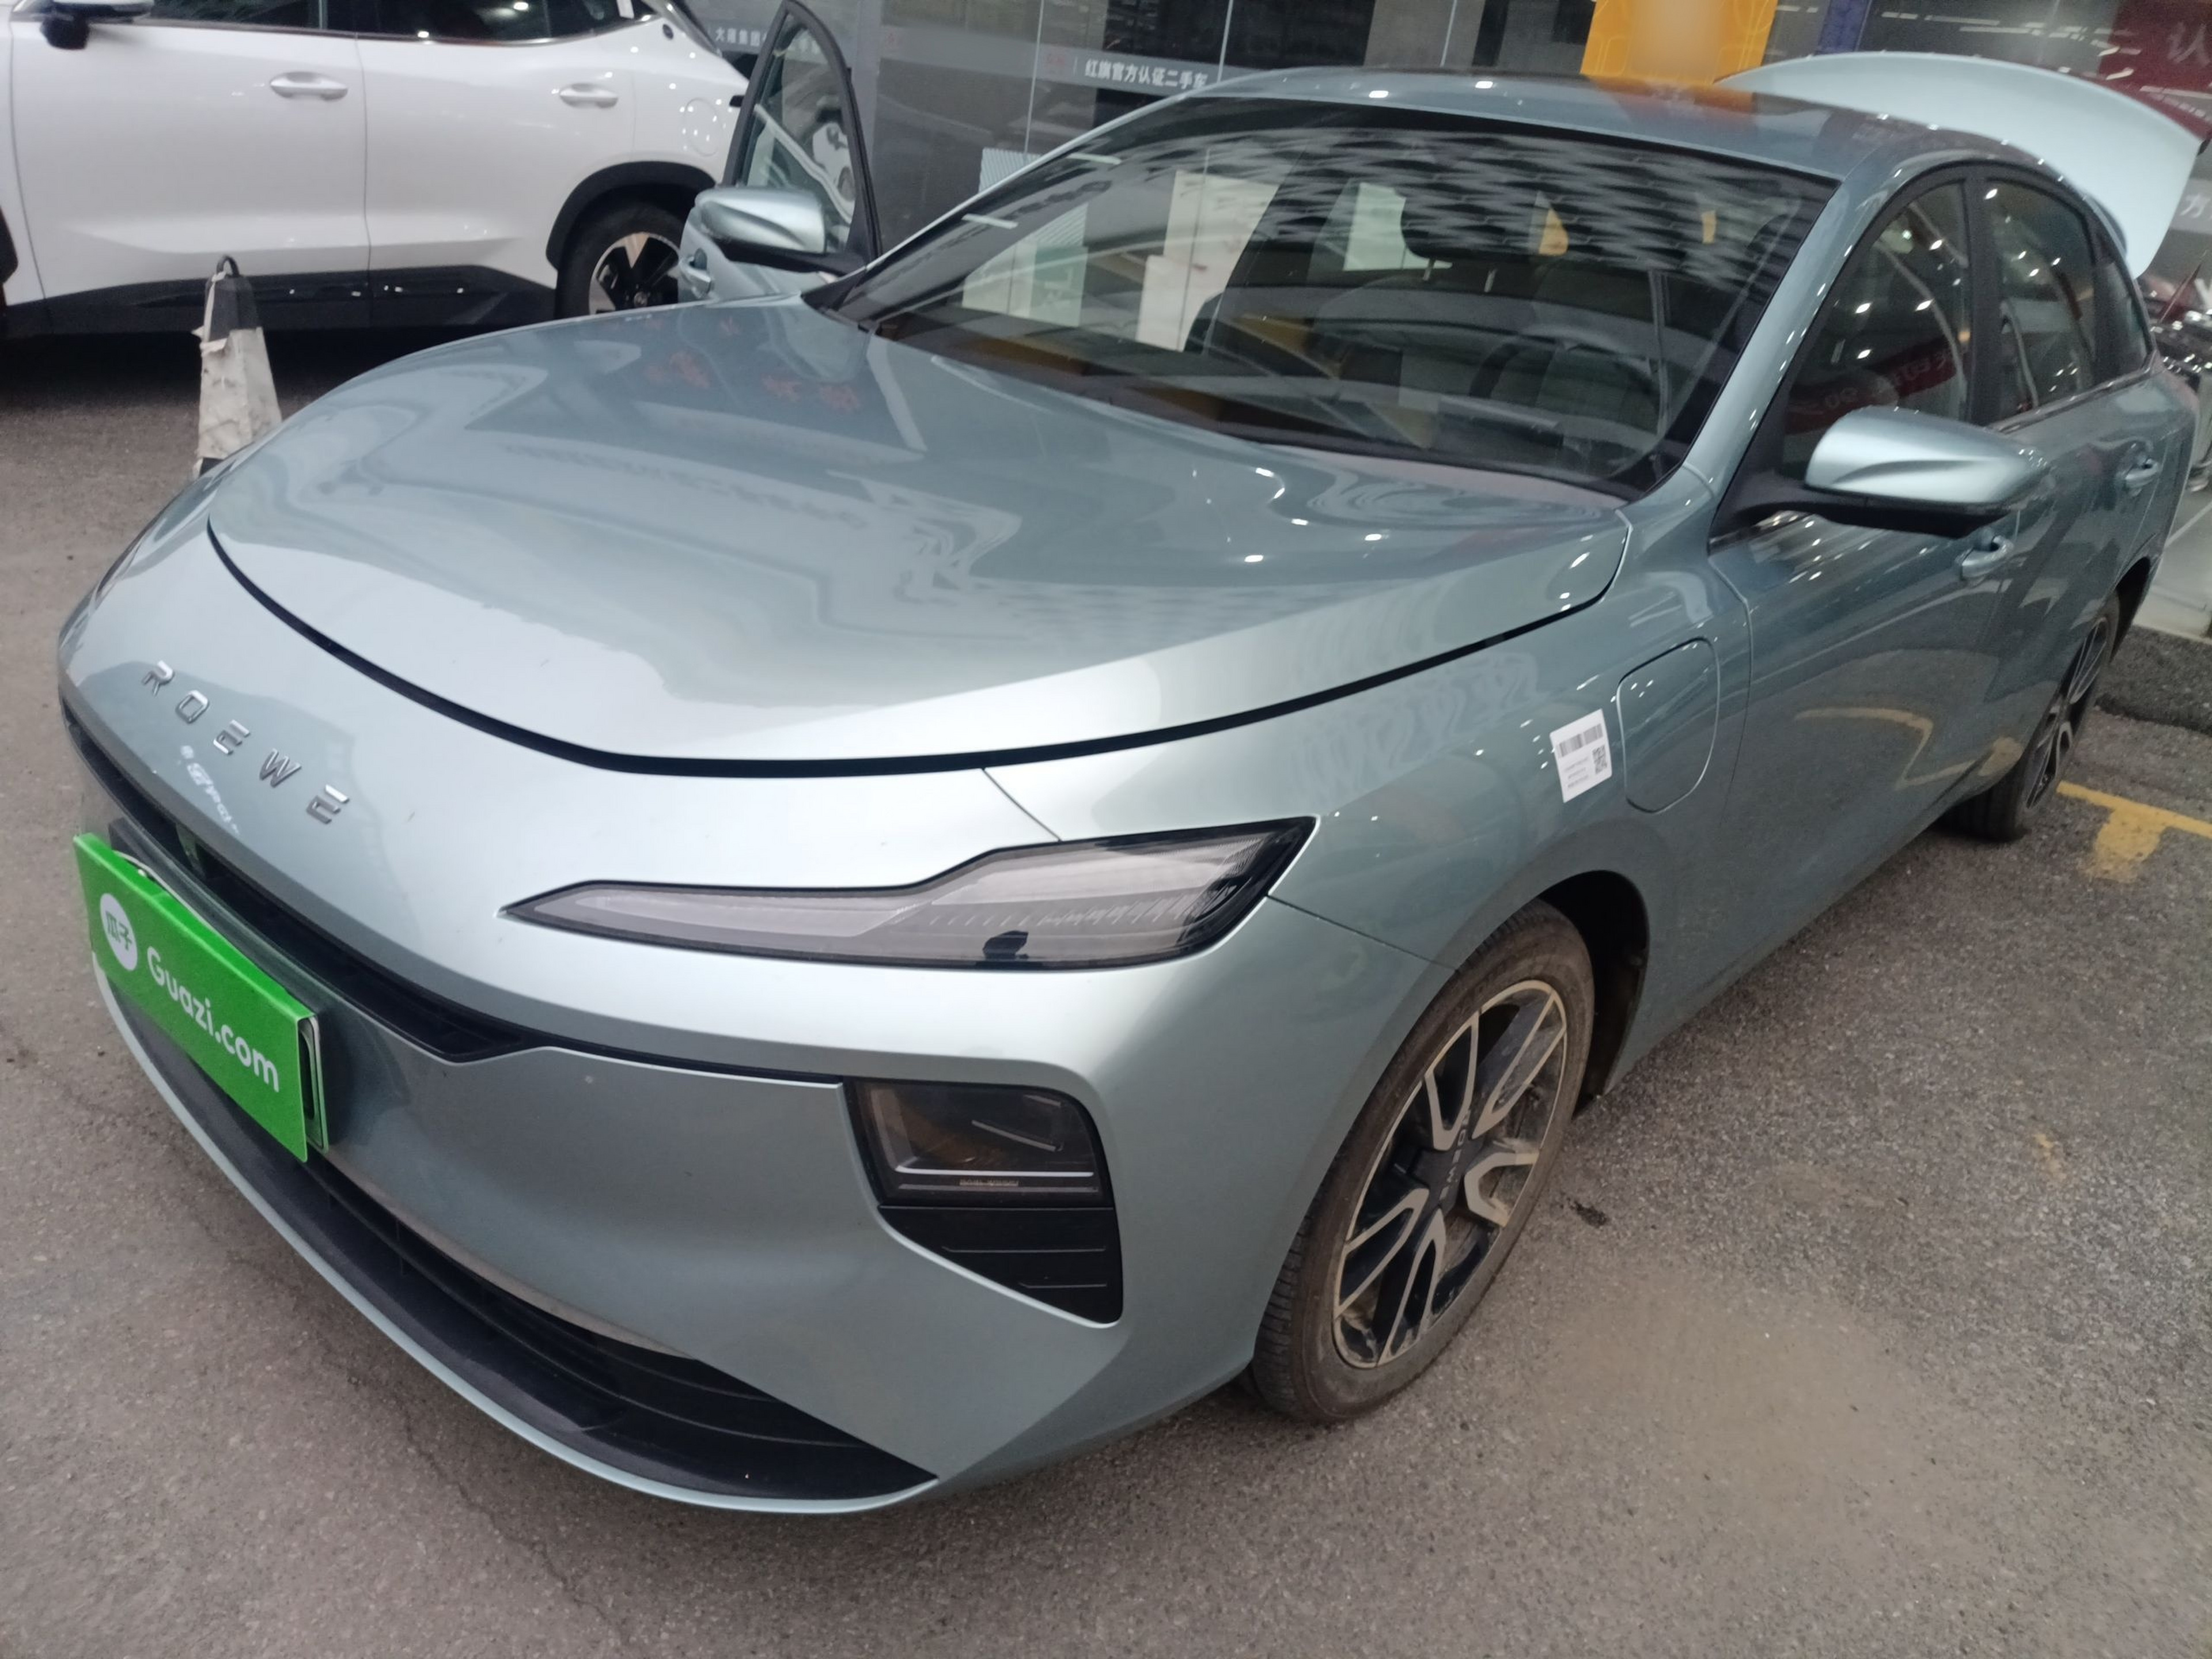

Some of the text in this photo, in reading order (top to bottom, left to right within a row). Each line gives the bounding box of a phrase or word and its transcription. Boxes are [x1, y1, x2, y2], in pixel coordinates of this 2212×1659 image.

[1085, 58, 1208, 89] 红旗官方认证二手车
[142, 660, 349, 824] ROEWE
[105, 910, 132, 952] 瓜子
[147, 946, 279, 1093] Guazi.com
